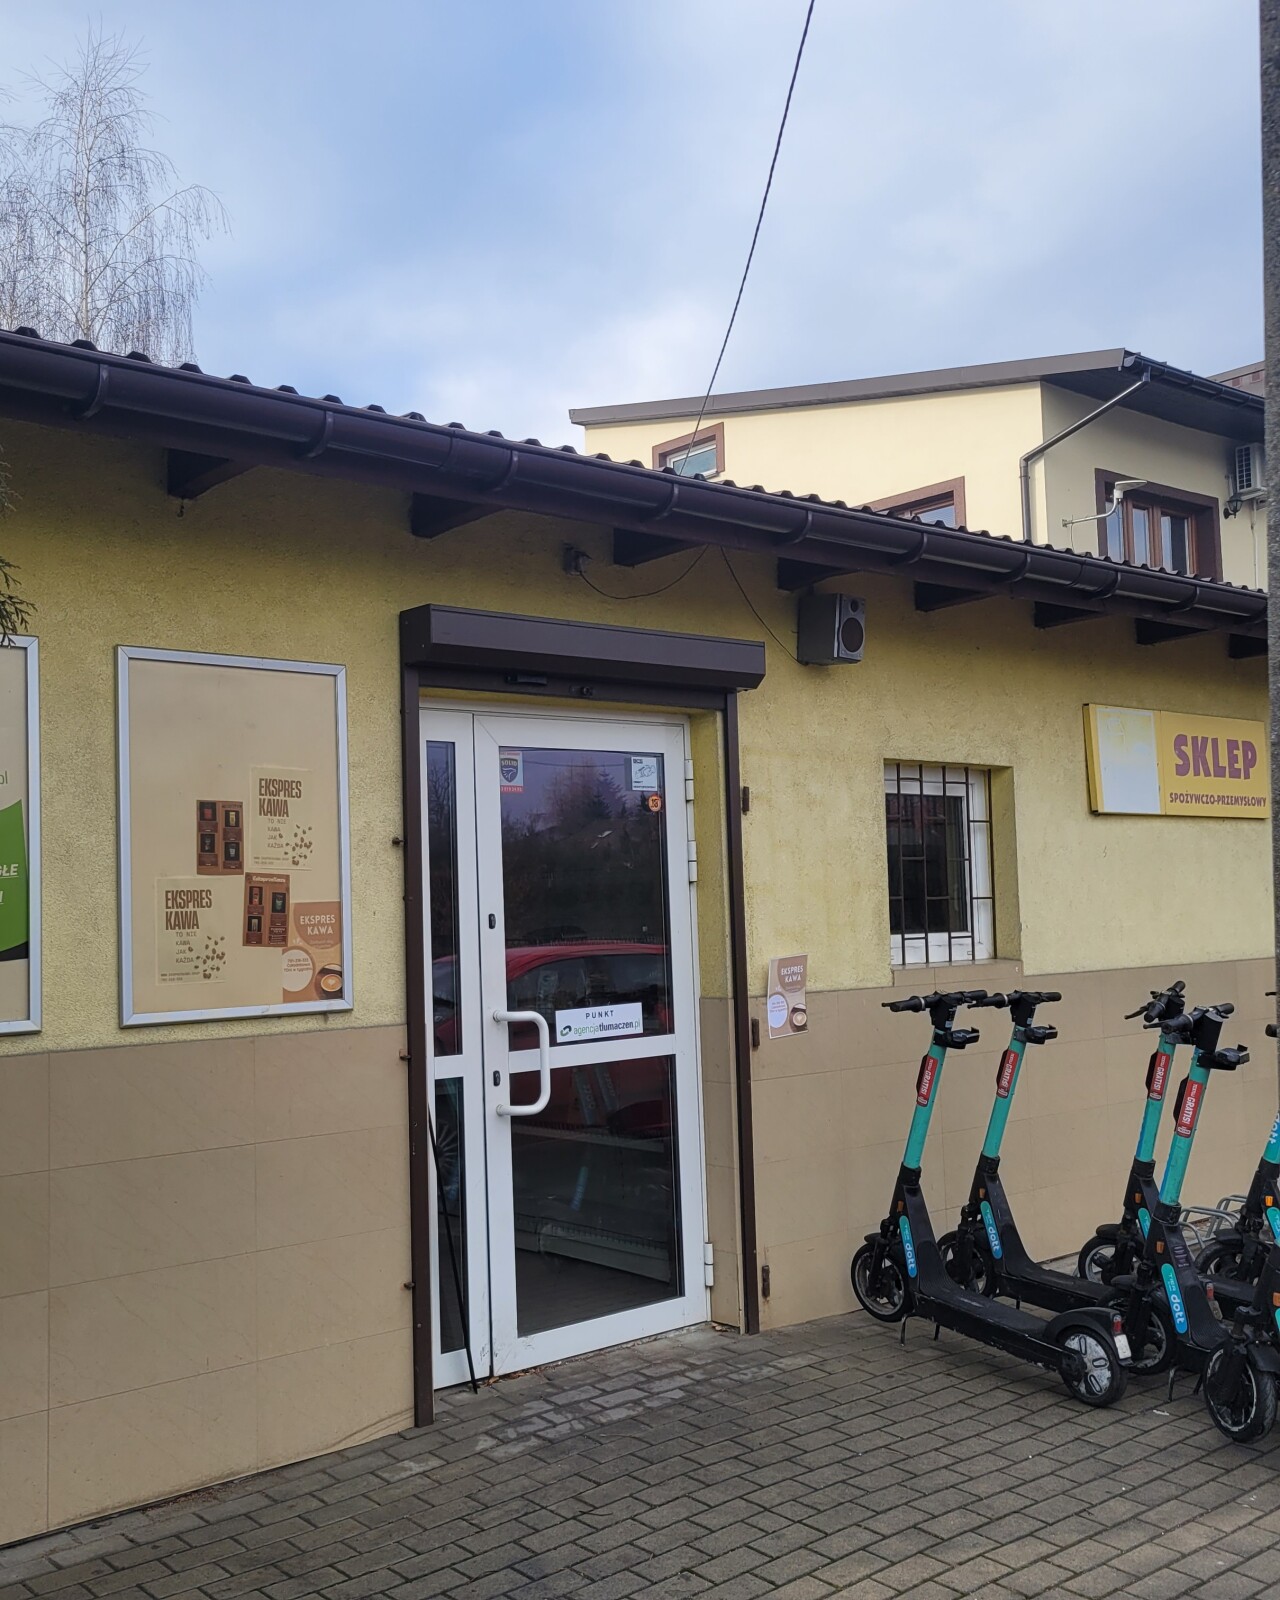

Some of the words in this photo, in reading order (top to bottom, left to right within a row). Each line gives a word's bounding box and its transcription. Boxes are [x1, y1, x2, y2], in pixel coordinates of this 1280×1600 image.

[1173, 733, 1257, 780] SKLEP
[258, 777, 302, 799] EKSPRES
[1169, 789, 1267, 808] SPOŻYWCZO-PRZEMYSŁOWY
[258, 797, 290, 818] KAWA
[165, 889, 212, 910] EKSPRES
[165, 910, 200, 931] KAWA
[300, 914, 336, 925] EKSPRES
[307, 925, 334, 936] KAWA
[781, 965, 804, 976] EKSPRES
[785, 974, 802, 983] KAWA
[585, 1009, 614, 1019] PUNKT
[1153, 1066, 1165, 1091] GRATIS!
[1181, 1096, 1196, 1125] GRATIS!
[988, 1226, 1000, 1251] dott
[905, 1243, 915, 1270] dott
[1171, 1294, 1185, 1324] dott
